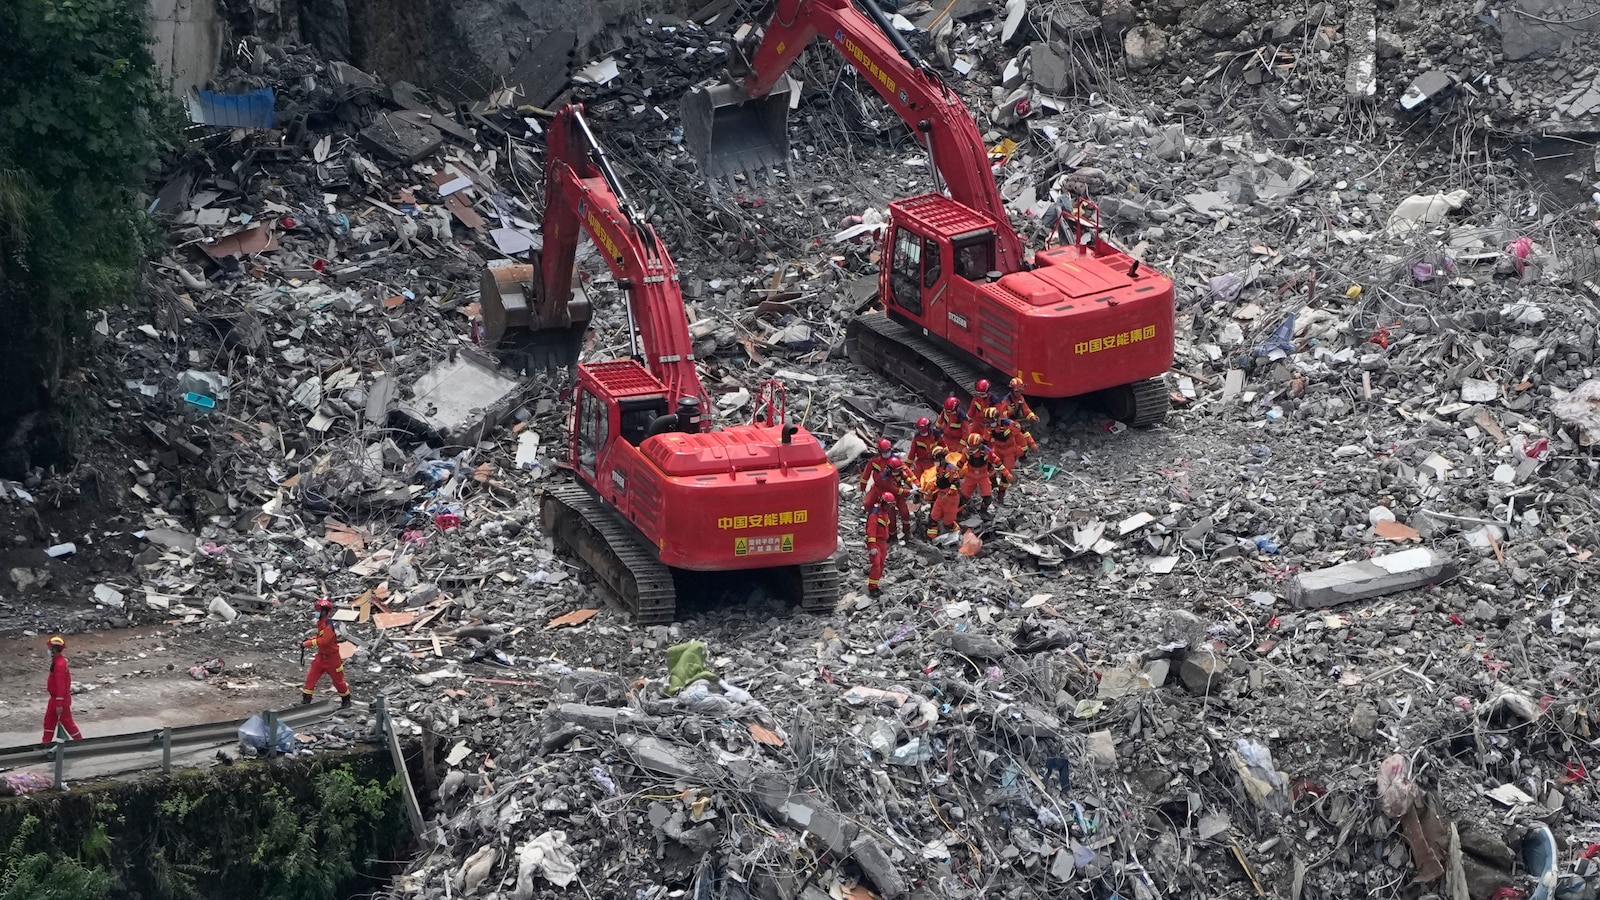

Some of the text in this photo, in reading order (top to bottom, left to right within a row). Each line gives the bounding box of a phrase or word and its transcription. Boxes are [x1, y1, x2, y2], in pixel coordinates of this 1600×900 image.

[845, 39, 895, 93] 中国安能集团
[588, 211, 624, 271] 中国安能集
[1074, 325, 1156, 355] 中国安能集团
[718, 510, 807, 530] 中国安能集团
